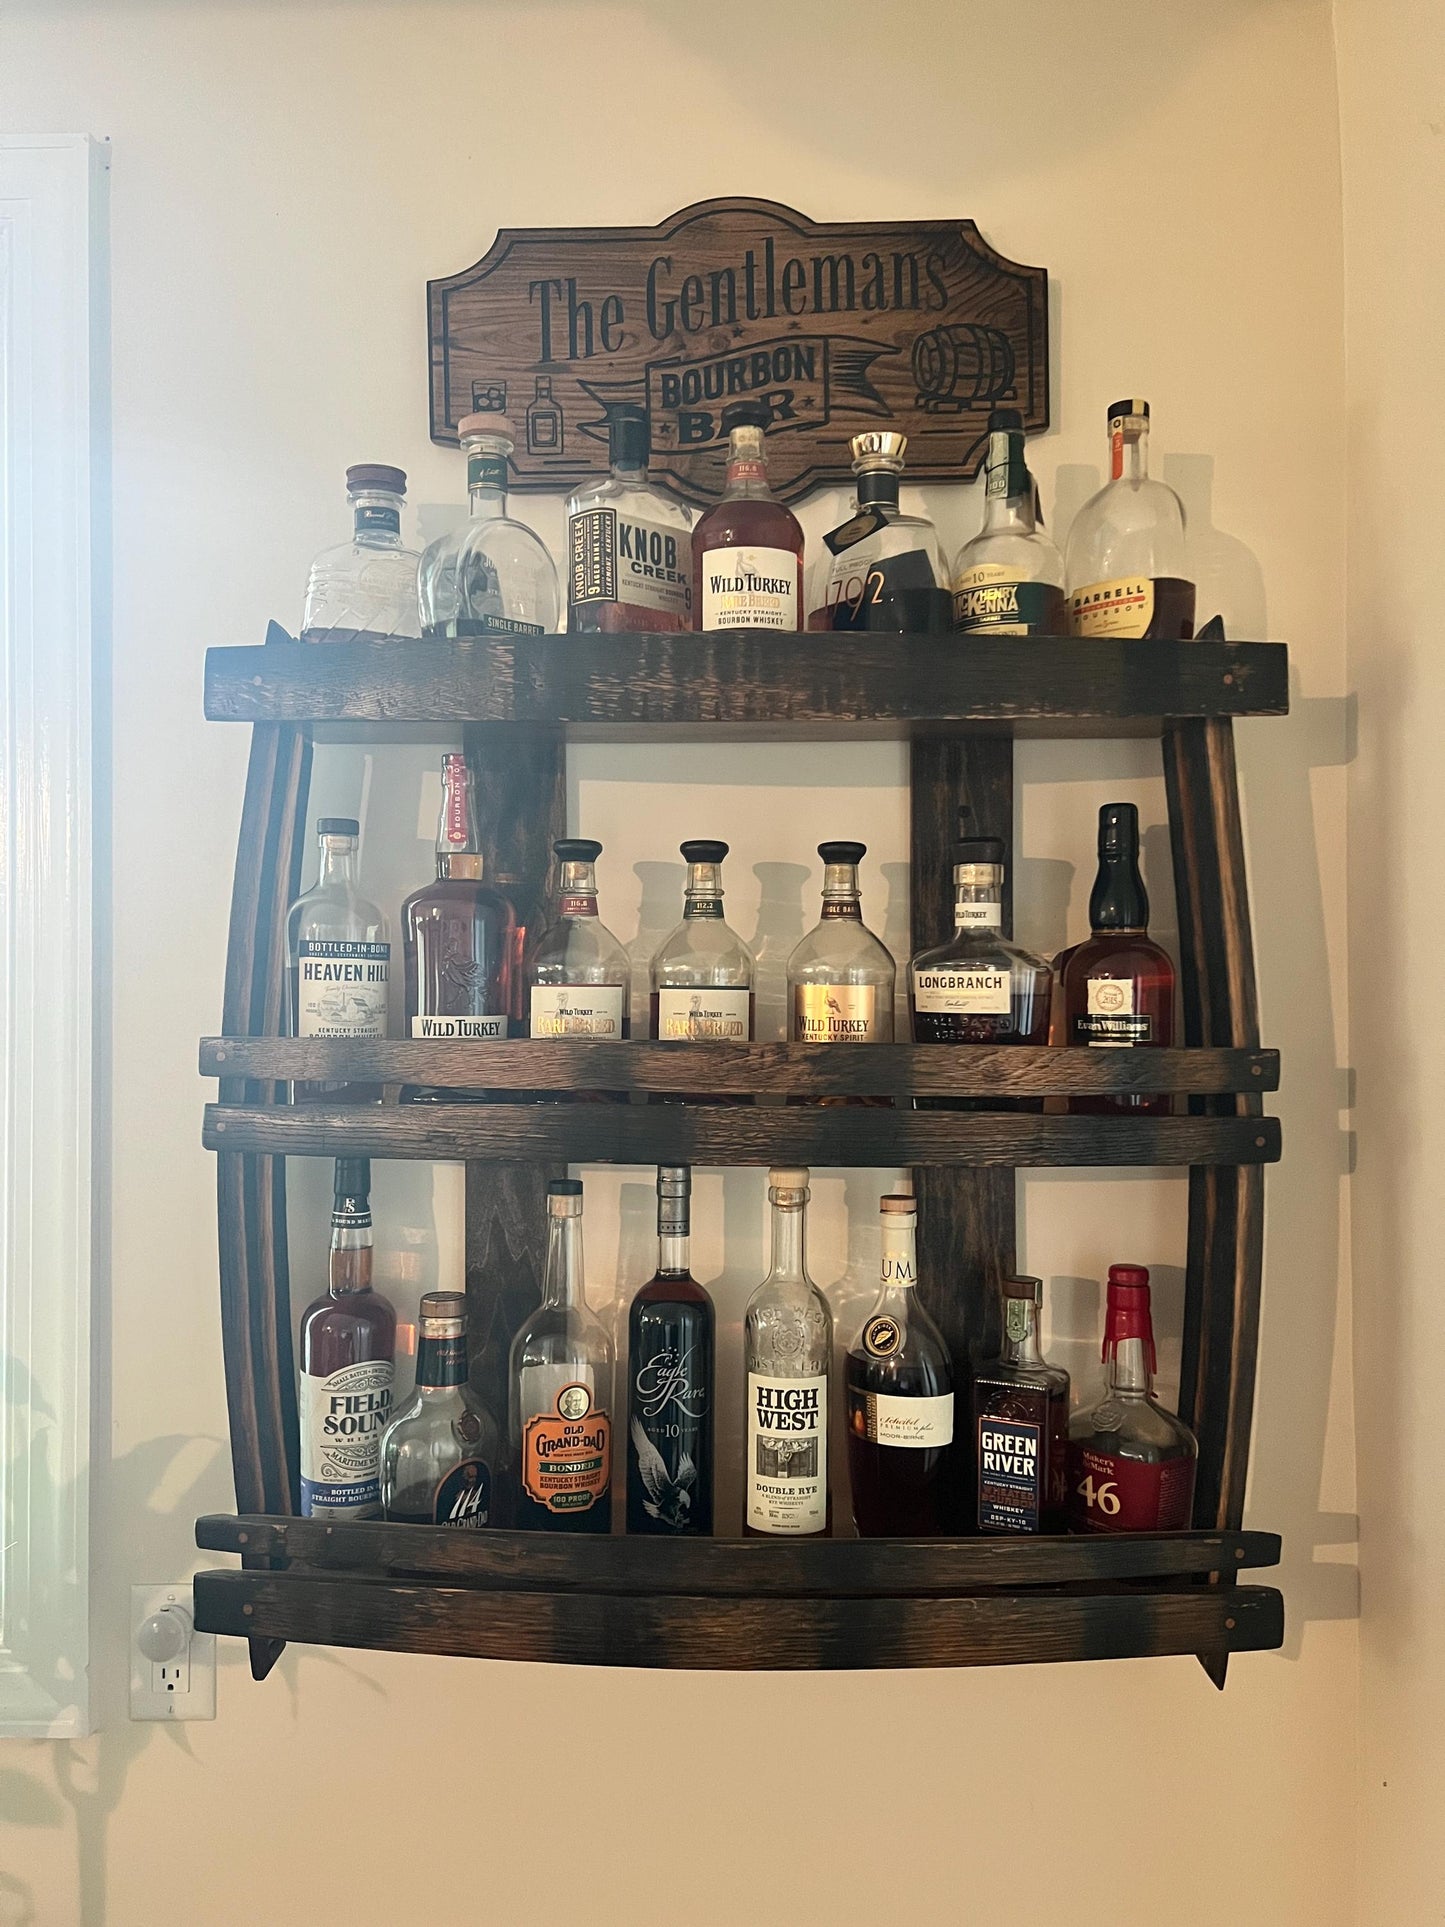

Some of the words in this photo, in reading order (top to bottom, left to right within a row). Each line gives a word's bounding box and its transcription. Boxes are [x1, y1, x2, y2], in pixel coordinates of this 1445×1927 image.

[529, 277, 625, 364] The
[645, 237, 949, 340] Gentlemans
[661, 344, 815, 409] BOURBON
[678, 388, 800, 444] BR
[592, 514, 600, 540] YEARS
[575, 519, 584, 562] CREEK
[619, 522, 677, 570] KNOB
[575, 563, 585, 599] KNOB
[630, 561, 687, 585] CREEK
[973, 571, 985, 584] 10
[588, 586, 601, 595] 9
[710, 575, 744, 594] WILD
[744, 573, 791, 595] TURKEY
[979, 586, 1018, 600] HENRY
[684, 587, 692, 610] 9
[825, 571, 885, 622] 1792
[1074, 584, 1144, 608] BARRELL
[487, 616, 512, 631] SINGLE
[718, 616, 751, 625] BOURBON
[753, 616, 784, 625] WHISKEY
[304, 963, 363, 981] HEAVEN
[367, 964, 389, 982] HILL
[919, 976, 1002, 989] LONGBRANCH
[558, 1008, 574, 1016] WILD
[573, 1008, 593, 1016] TURKEY
[421, 1019, 455, 1036] WILD
[455, 1019, 501, 1038] TURKEY
[537, 1016, 570, 1034] RARE
[665, 1018, 700, 1036] RARE
[701, 1019, 743, 1036] BREED
[798, 1015, 825, 1032] WILD
[825, 1016, 869, 1033] TURKEY
[1077, 1019, 1102, 1031] Evan
[1101, 1020, 1148, 1031] Williams
[801, 1033, 838, 1041] KENTUCKY
[840, 1033, 864, 1041] SPIRIT
[332, 1376, 350, 1387] SMALL
[349, 1369, 368, 1379] BATCH
[637, 1345, 697, 1402] Eagle
[330, 1388, 390, 1414] FIELD
[643, 1378, 709, 1417] Rare
[756, 1386, 819, 1410] HIGH
[323, 1408, 389, 1435] SOUN
[756, 1408, 819, 1431] WEST
[563, 1425, 584, 1435] OLD
[664, 1424, 680, 1438] 10
[536, 1429, 605, 1458] GRAND-DAD
[981, 1431, 1037, 1457] GREEN
[330, 1451, 368, 1467] MARITIME
[549, 1461, 594, 1472] BONDED
[983, 1451, 1035, 1477] RIVER
[1082, 1450, 1115, 1467] Maker's
[539, 1475, 573, 1483] KENTUCKY
[574, 1470, 601, 1482] STRAIGHT
[1090, 1461, 1114, 1476] Mark
[331, 1487, 365, 1495] BOTTLED
[539, 1482, 573, 1490] BOURBON
[756, 1483, 795, 1495] DOUBLE
[798, 1485, 818, 1495] RYE
[984, 1480, 1009, 1488] KENTUCKY
[1009, 1484, 1033, 1492] STRAIGHT
[1076, 1474, 1121, 1515] 46
[311, 1493, 347, 1502] STRAIGHT
[449, 1482, 484, 1519] 114
[553, 1495, 567, 1503] 100
[567, 1493, 590, 1502] PROOF
[992, 1504, 1024, 1514] WHISKEY
